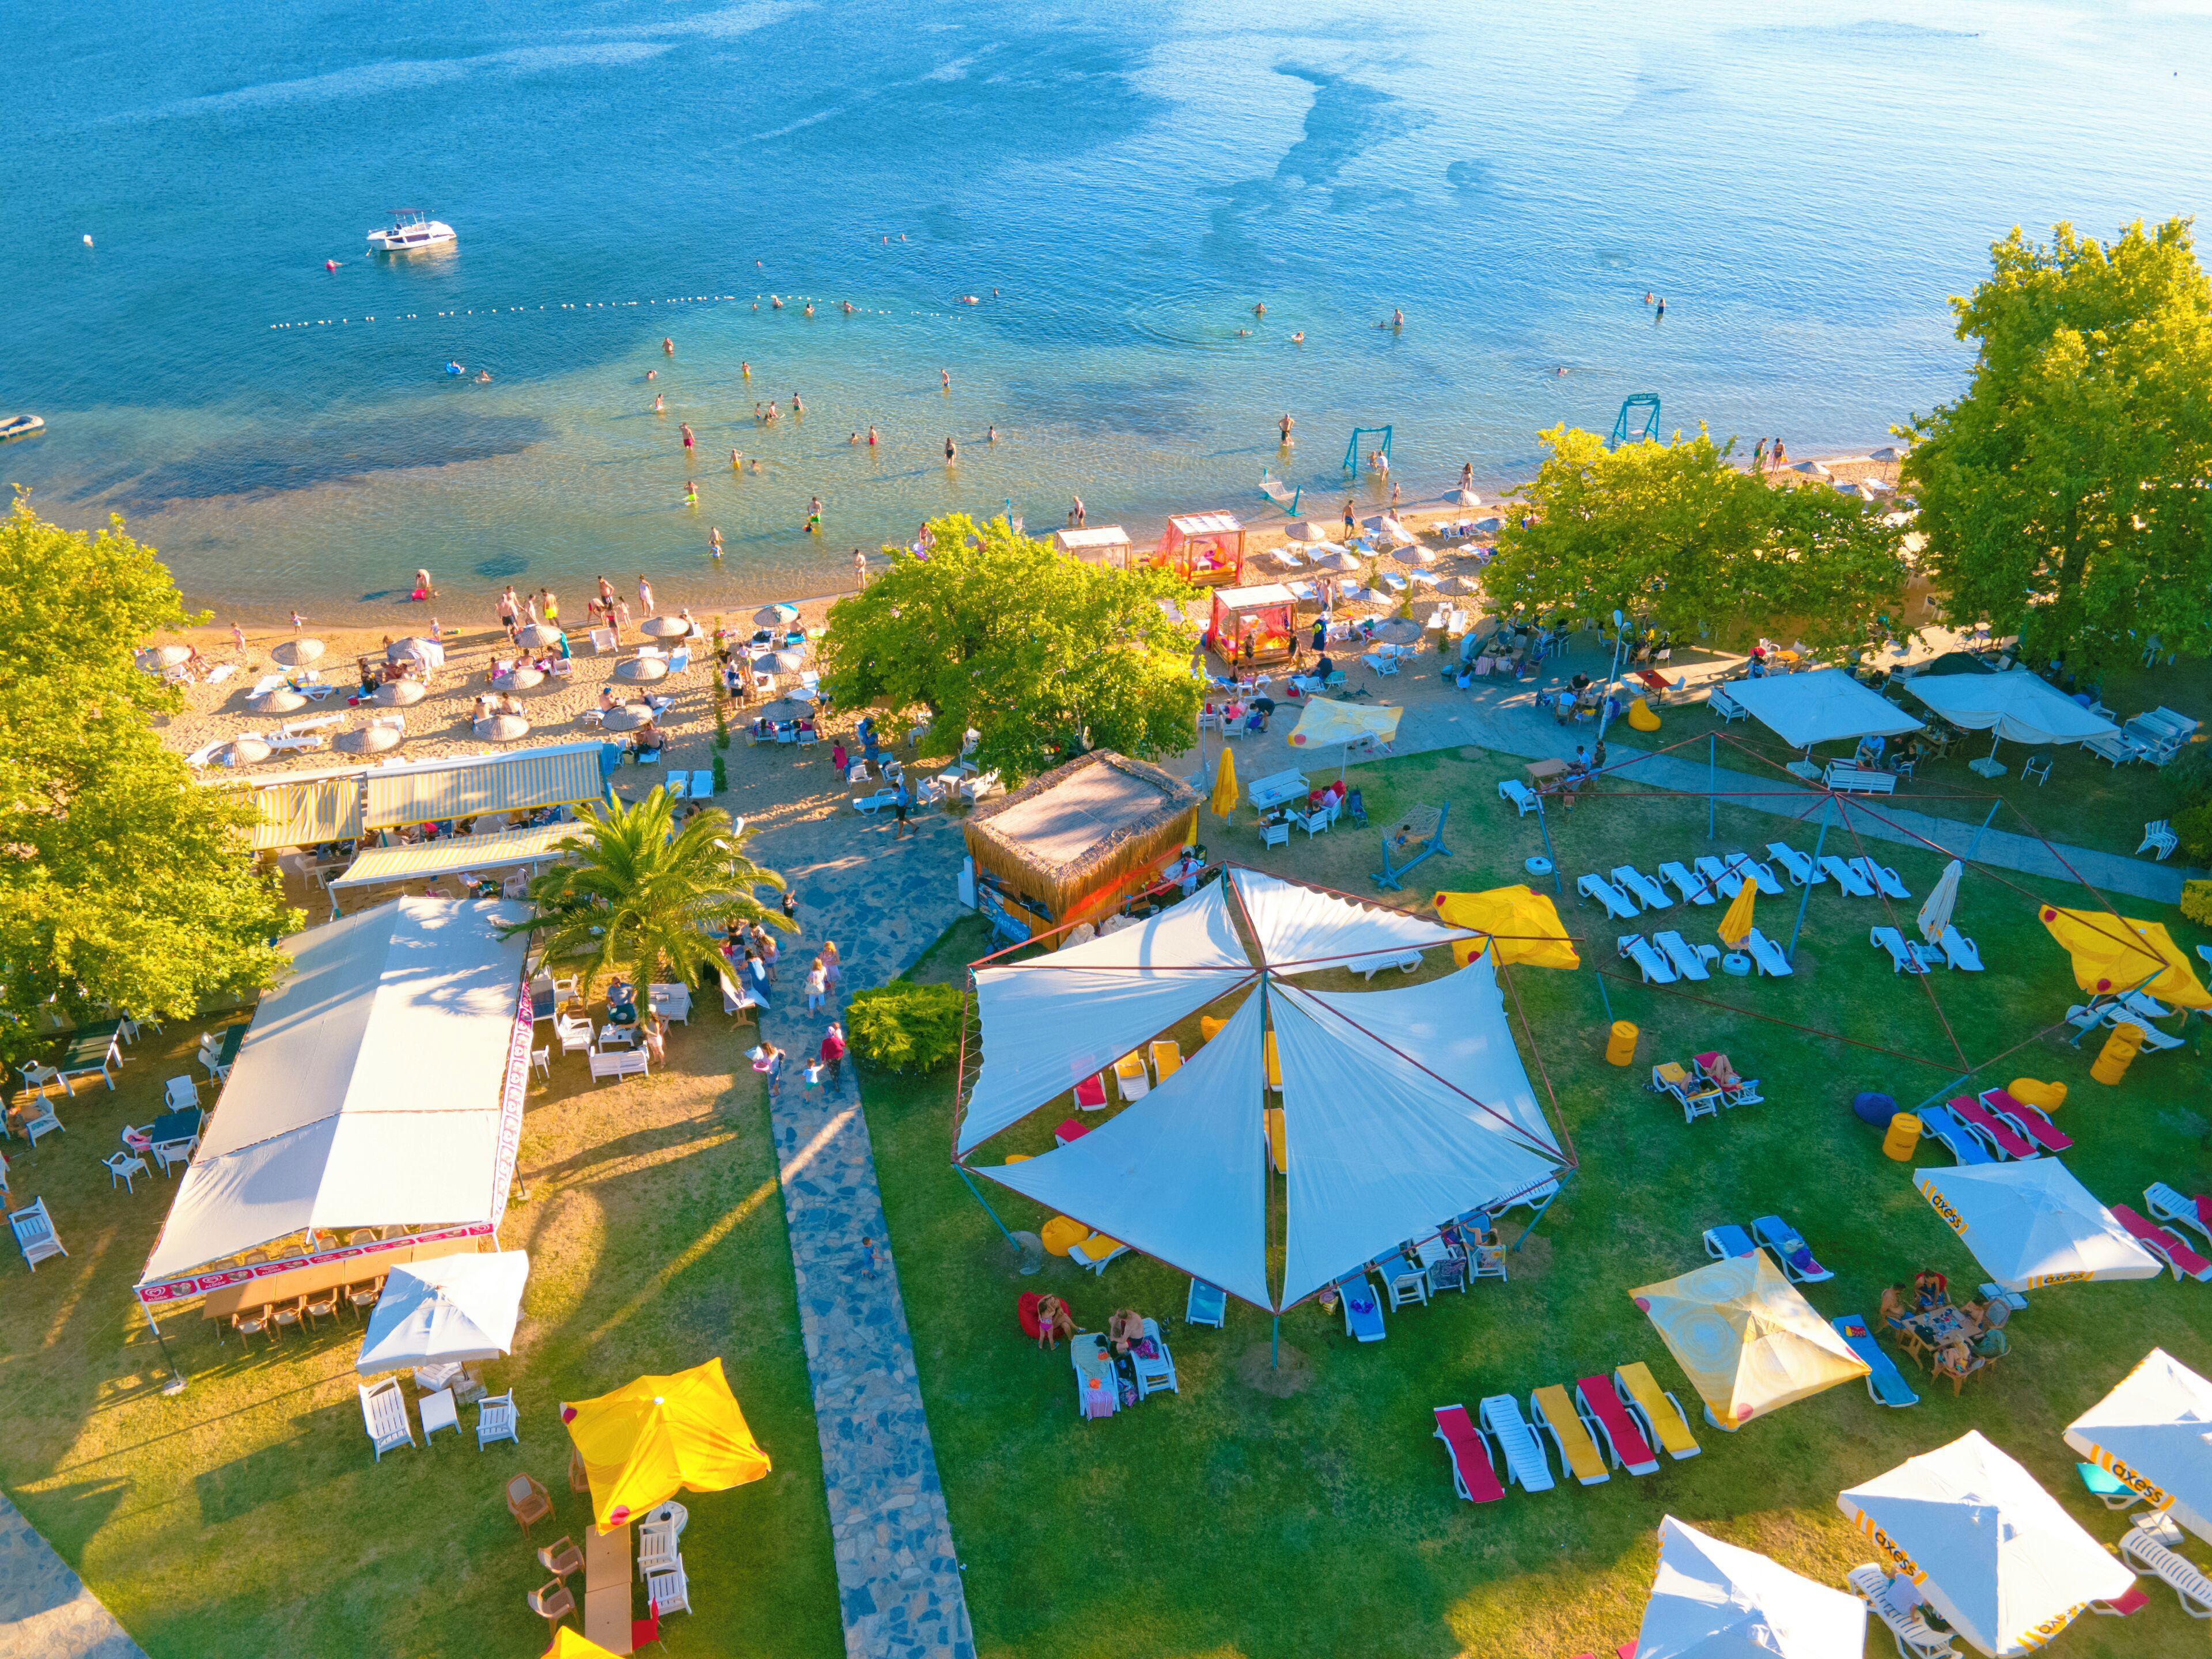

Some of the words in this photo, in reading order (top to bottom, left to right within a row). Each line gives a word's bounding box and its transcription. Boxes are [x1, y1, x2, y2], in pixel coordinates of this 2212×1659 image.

[997, 916, 1010, 929] FAST
[1011, 925, 1027, 940] FOOD
[1933, 1195, 1961, 1228] axess
[205, 1279, 226, 1289] ALGIDA
[2112, 1464, 2164, 1503] axess
[1875, 1532, 1917, 1577] axess
